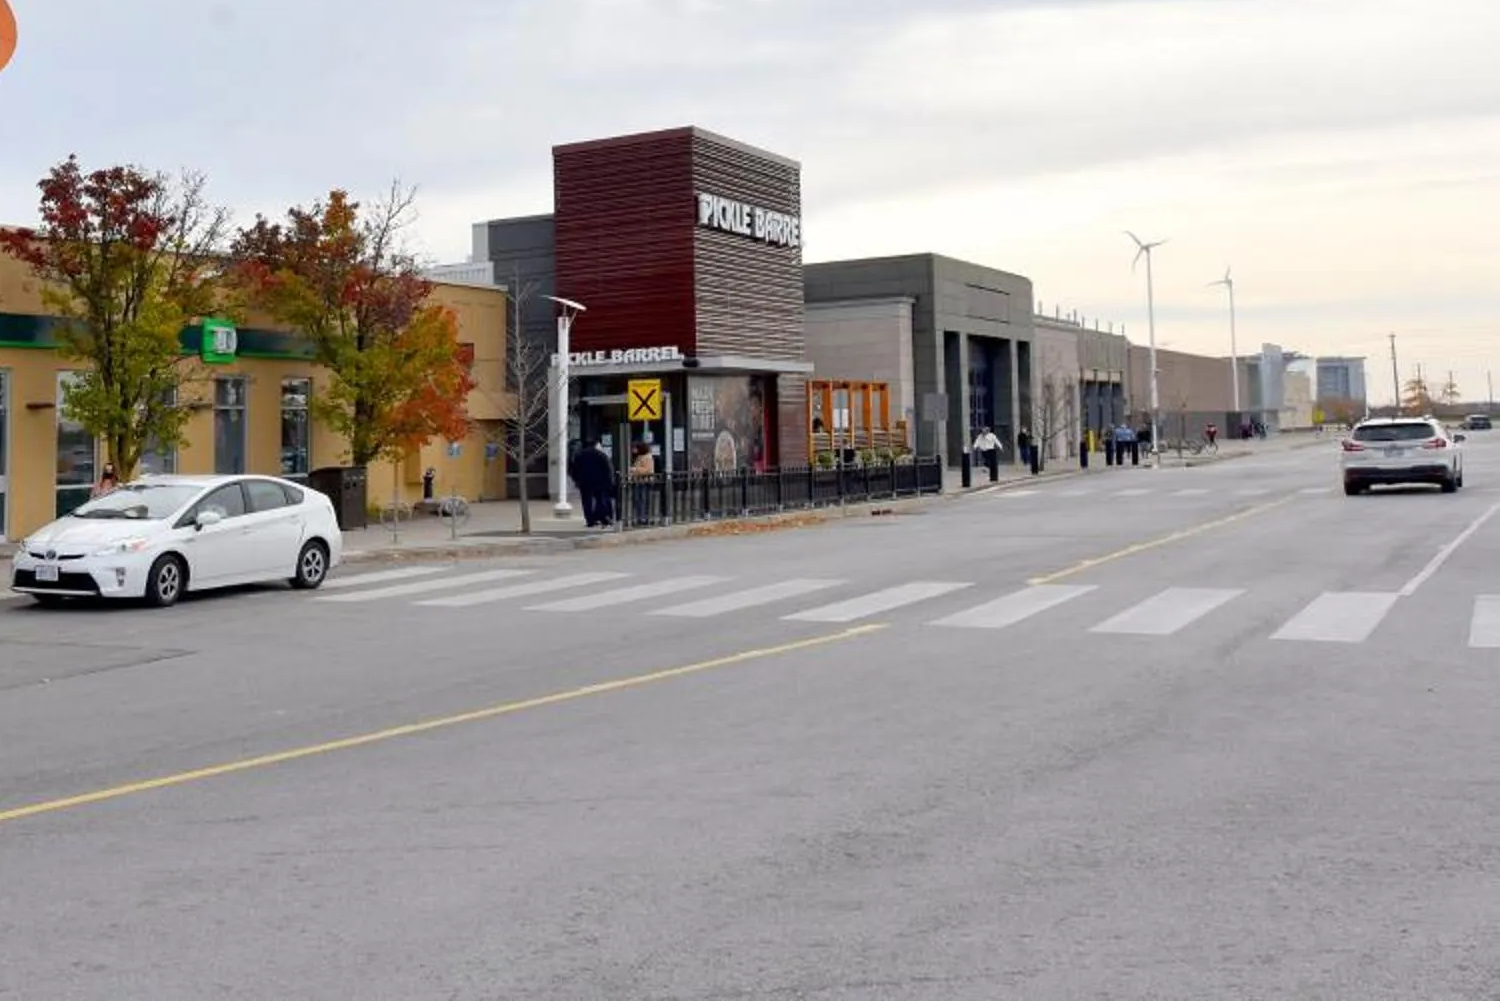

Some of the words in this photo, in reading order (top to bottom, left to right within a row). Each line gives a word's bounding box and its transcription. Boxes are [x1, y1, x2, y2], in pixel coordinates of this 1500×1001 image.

[699, 193, 751, 235] PICKLE
[756, 207, 803, 248] BARRE
[551, 350, 606, 366] PCKLE
[611, 346, 685, 364] BARREL
